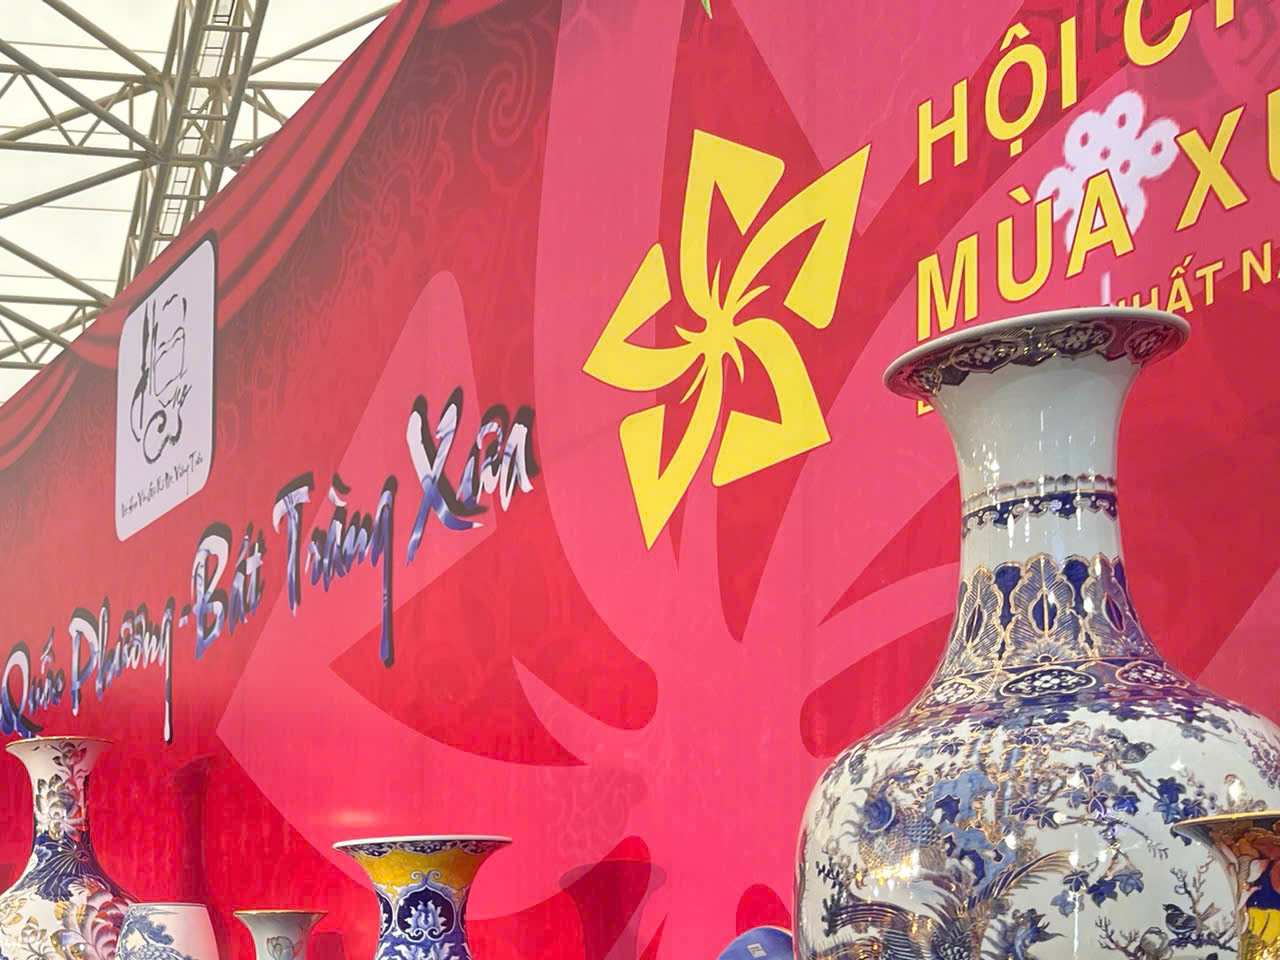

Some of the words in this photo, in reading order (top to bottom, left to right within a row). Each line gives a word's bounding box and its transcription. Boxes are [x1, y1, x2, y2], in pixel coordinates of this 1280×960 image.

[917, 15, 1078, 186] HỘI
[1123, 0, 1233, 66] C
[917, 171, 1134, 341] MÙA
[1176, 88, 1280, 231] X
[1242, 241, 1280, 291] N
